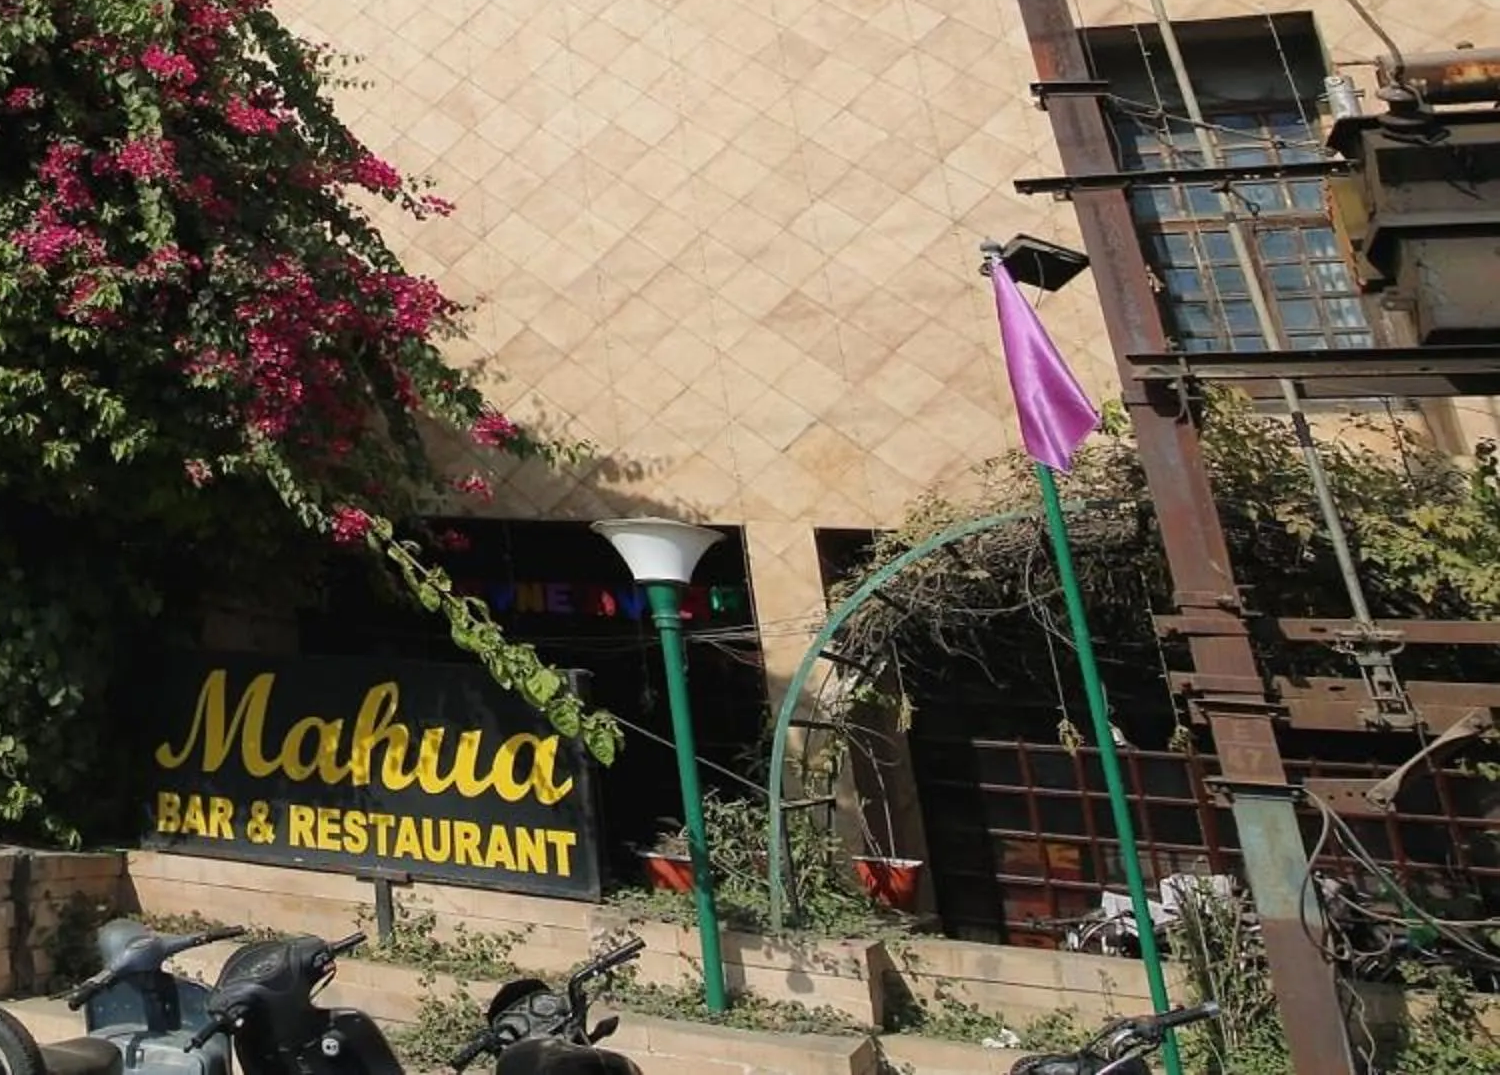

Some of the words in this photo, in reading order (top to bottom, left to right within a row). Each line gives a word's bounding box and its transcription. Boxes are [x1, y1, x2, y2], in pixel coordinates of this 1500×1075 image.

[155, 669, 573, 804] Mahua
[157, 793, 233, 840] BAR
[247, 801, 276, 845] &
[288, 805, 575, 877] RESTAURANT
